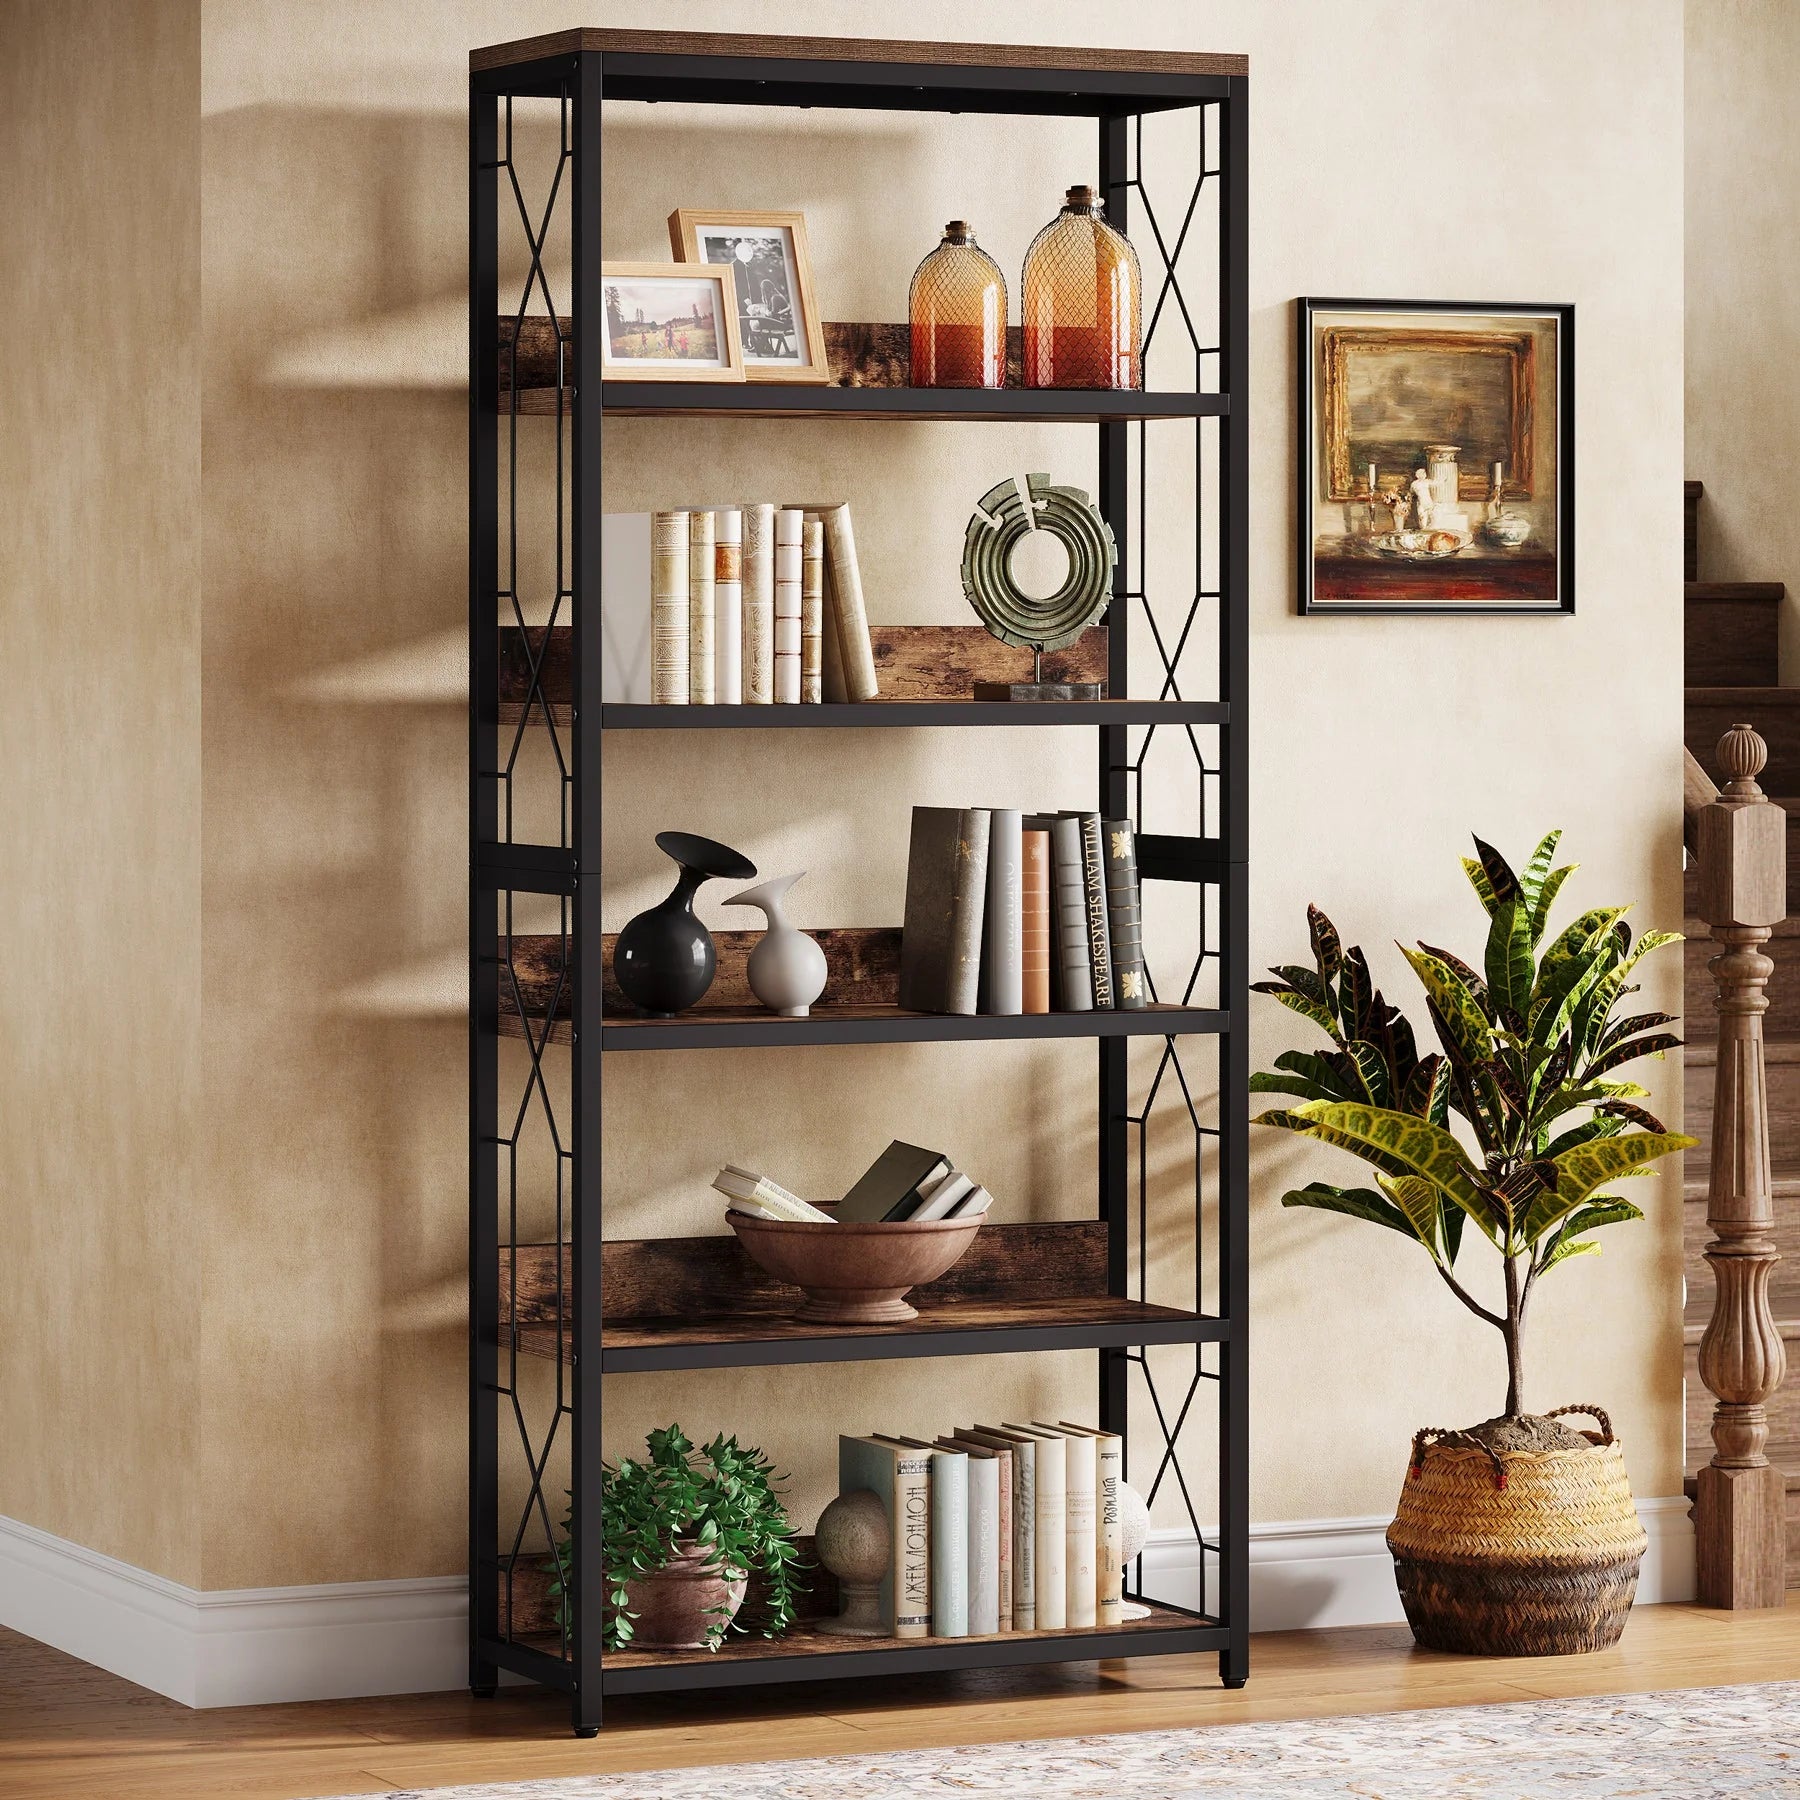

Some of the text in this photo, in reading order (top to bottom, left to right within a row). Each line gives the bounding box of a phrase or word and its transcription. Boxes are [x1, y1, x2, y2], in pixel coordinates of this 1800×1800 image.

[1083, 818, 1111, 1006] WILLIAM SHAKESPEARE
[906, 1487, 928, 1605] ДЖЕК ЛОНДОН
